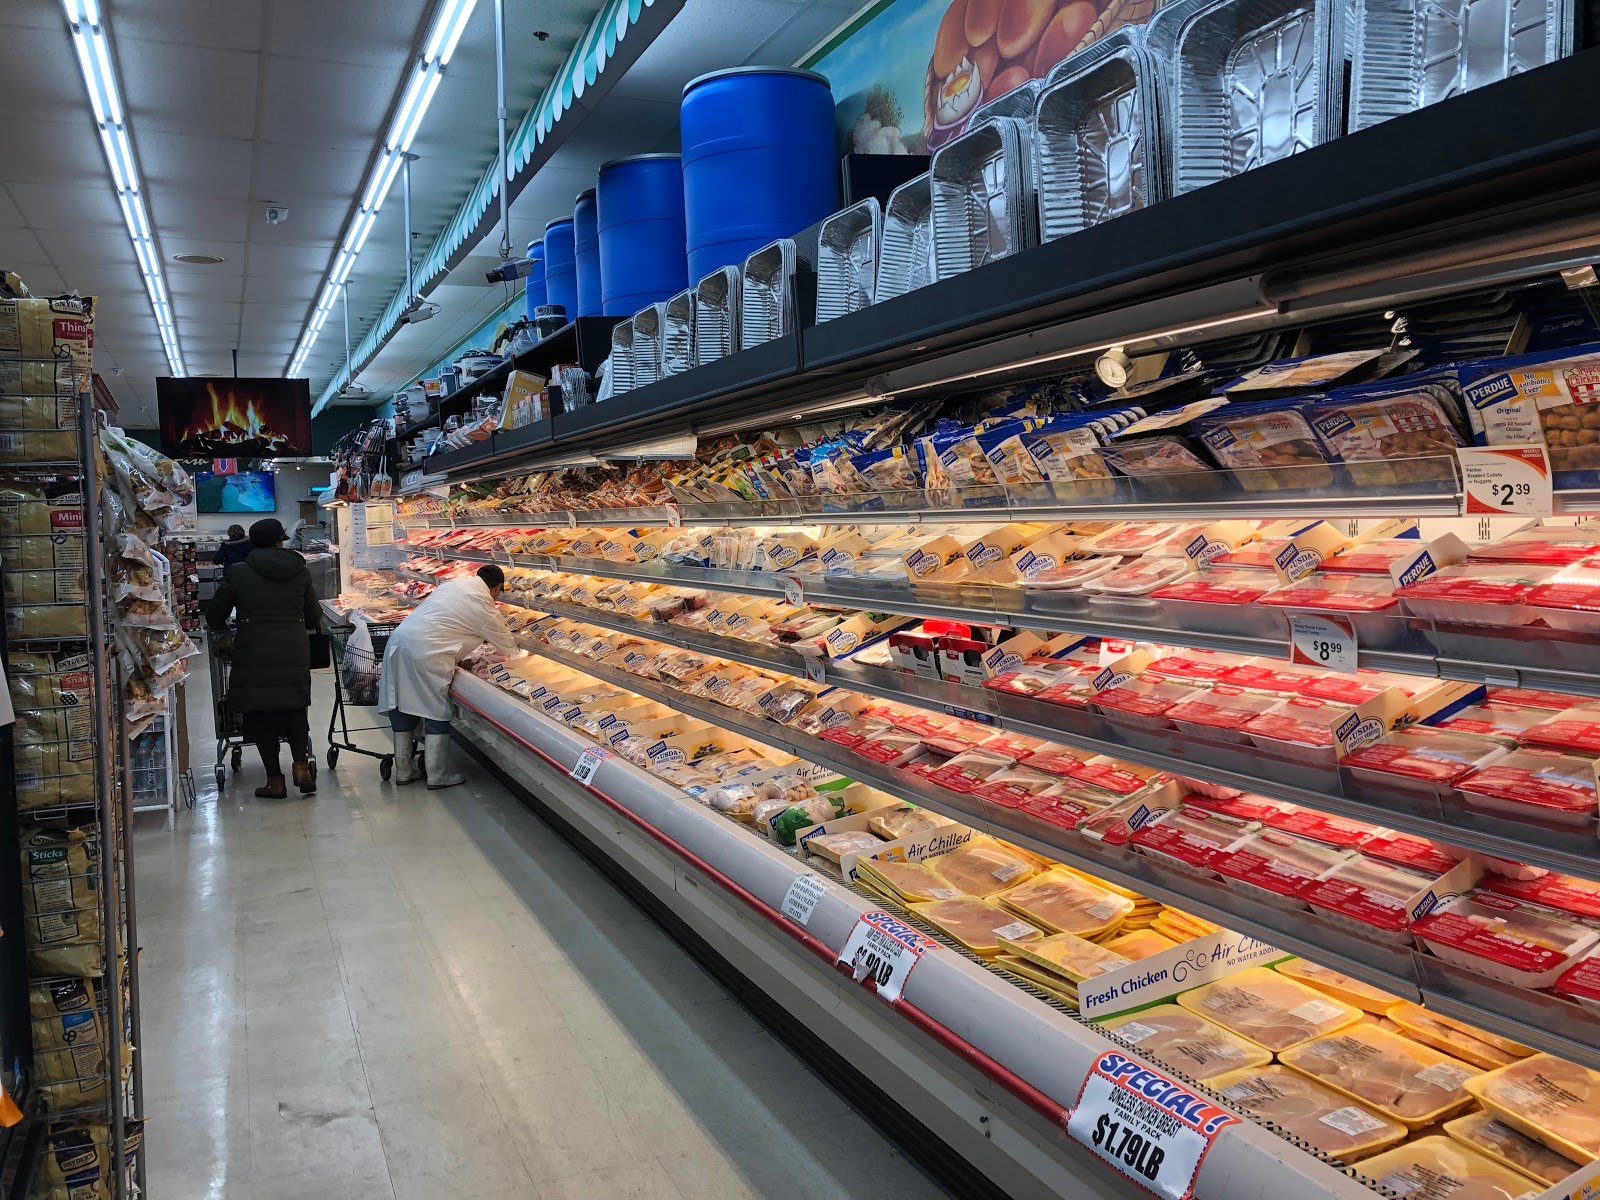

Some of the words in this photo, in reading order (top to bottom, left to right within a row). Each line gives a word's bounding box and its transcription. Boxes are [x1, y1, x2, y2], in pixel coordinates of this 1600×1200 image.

[60, 322, 86, 332] Thins
[1470, 377, 1511, 401] PERDUE
[1519, 378, 1551, 390] Antibiotics
[1524, 386, 1541, 394] Ever!
[1268, 422, 1292, 430] Strips
[1320, 413, 1348, 431] PERDUE
[58, 512, 82, 521] Mini
[1188, 536, 1204, 553] PERDUE
[1202, 545, 1221, 557] USDA
[918, 556, 934, 566] USDA
[979, 549, 995, 560] USDA
[1278, 546, 1295, 564] PERDUE
[1293, 553, 1313, 568] USDA
[1031, 558, 1047, 571] USDA
[1402, 555, 1430, 586] PERDUE
[1000, 655, 1016, 667] USDA
[1095, 669, 1113, 687] PERDUE
[1337, 714, 1358, 737] PERDUE
[1352, 723, 1374, 740] USDA
[660, 750, 678, 759] USDA
[1129, 806, 1146, 826] PERDUE
[908, 844, 927, 859] Air
[929, 830, 972, 852] Chilled
[33, 850, 63, 860] Sticks
[1414, 892, 1434, 919] PERDUE
[866, 912, 920, 948] SPECIAL
[881, 949, 892, 960] PACK
[1211, 943, 1235, 963] Air
[1237, 952, 1258, 963] WATER
[1086, 984, 1119, 1009] Fresh
[1121, 968, 1168, 995] Chicken
[1099, 1053, 1211, 1127] SPECIAL
[1108, 1087, 1138, 1113] BONELESS
[1134, 1098, 1160, 1127] CHICKEN
[1155, 1114, 1182, 1139] BREAST
[1114, 1107, 1141, 1127] FAMILY
[1141, 1123, 1163, 1141] PACK
[1091, 1113, 1166, 1181] $1.79LB
